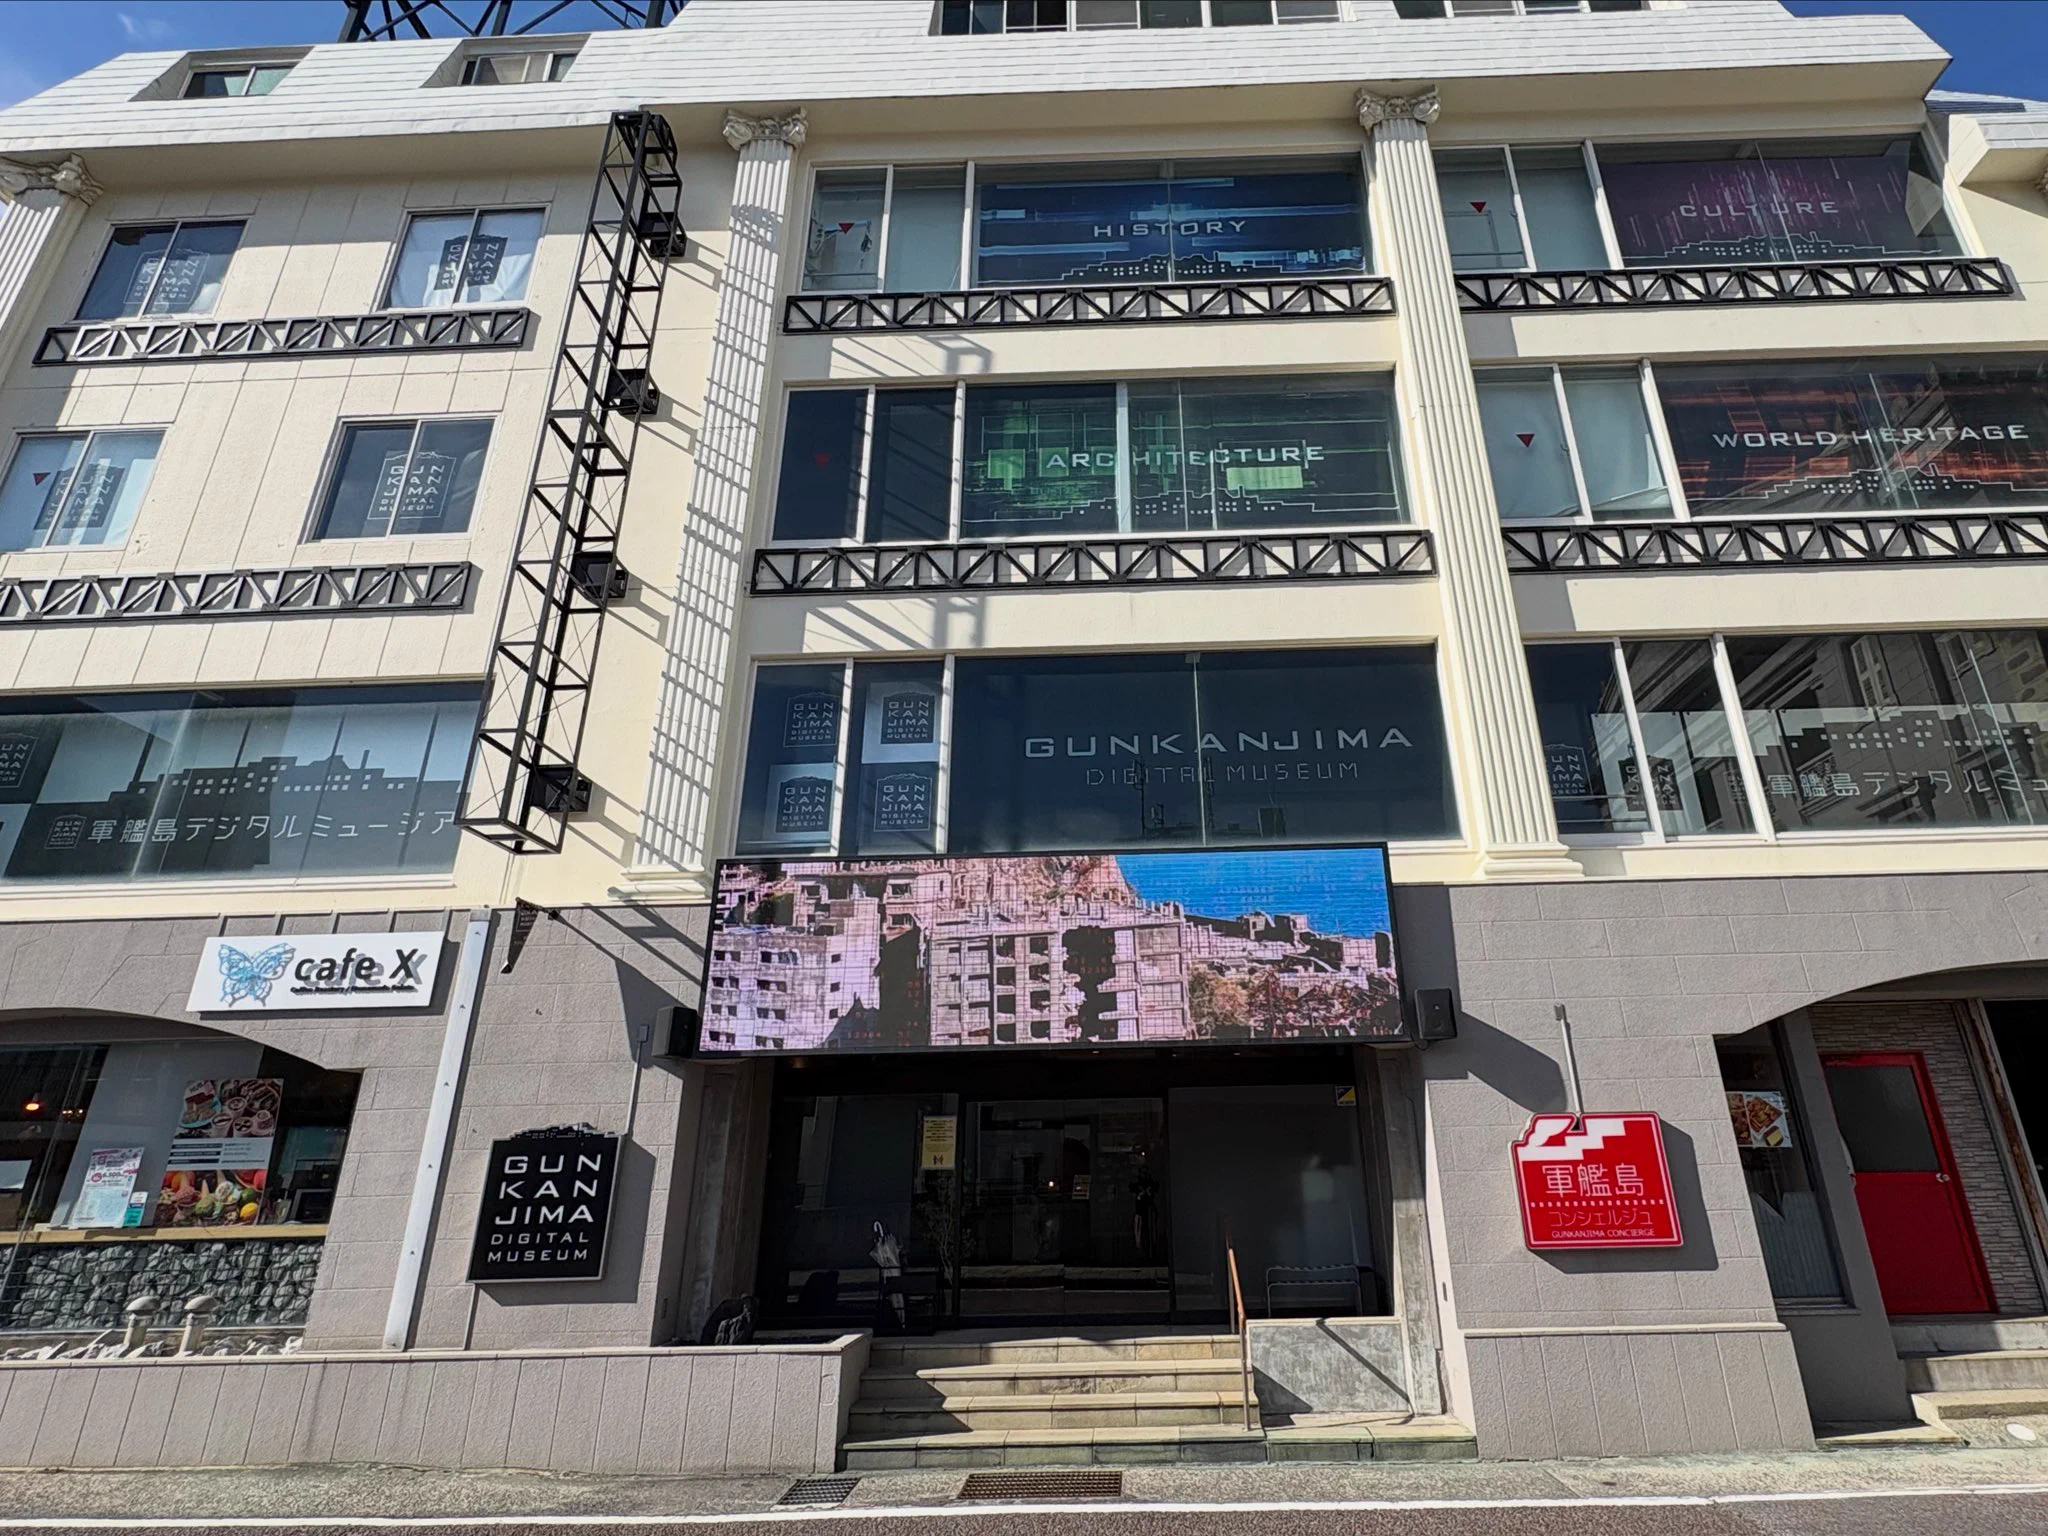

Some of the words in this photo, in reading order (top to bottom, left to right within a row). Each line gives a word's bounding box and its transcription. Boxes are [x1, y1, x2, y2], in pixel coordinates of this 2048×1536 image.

[1680, 202, 1838, 217] CULTURE
[1094, 221, 1245, 237] HISTORY
[139, 276, 192, 285] JMA
[1713, 431, 1837, 448] WORLD
[1853, 425, 2029, 445] HERITAGE
[1047, 446, 1324, 468] ARCHITECTURE
[384, 487, 438, 496] JMA
[794, 703, 834, 711] GUN
[888, 701, 929, 709] GUN
[793, 711, 833, 720] KAN
[888, 709, 929, 718] KAN
[792, 720, 832, 728] JIMA
[887, 718, 929, 727] JIMA
[1025, 727, 1413, 758] GUNKANJIMA
[1086, 764, 1215, 786] DIGITAL
[1226, 761, 1359, 783] MUSEUM
[785, 786, 827, 795] GUN
[883, 784, 925, 793] GUN
[784, 796, 826, 804] KAN
[882, 794, 925, 803] KAN
[783, 805, 825, 814] JIMA
[882, 803, 924, 812] JIMA
[295, 948, 376, 981] cafe
[389, 949, 419, 979] X
[504, 1154, 601, 1174] GUN
[1542, 1163, 1644, 1198] 軍艦島
[499, 1179, 598, 1200] KAN
[495, 1204, 594, 1225] JIMA
[1548, 1207, 1653, 1227] コンシェルジュ
[491, 1232, 589, 1245] DIGITAL
[1552, 1230, 1605, 1239] GUNKANJIMA
[1607, 1228, 1655, 1237] CONCIERGE
[487, 1249, 587, 1263] MUSEUM
